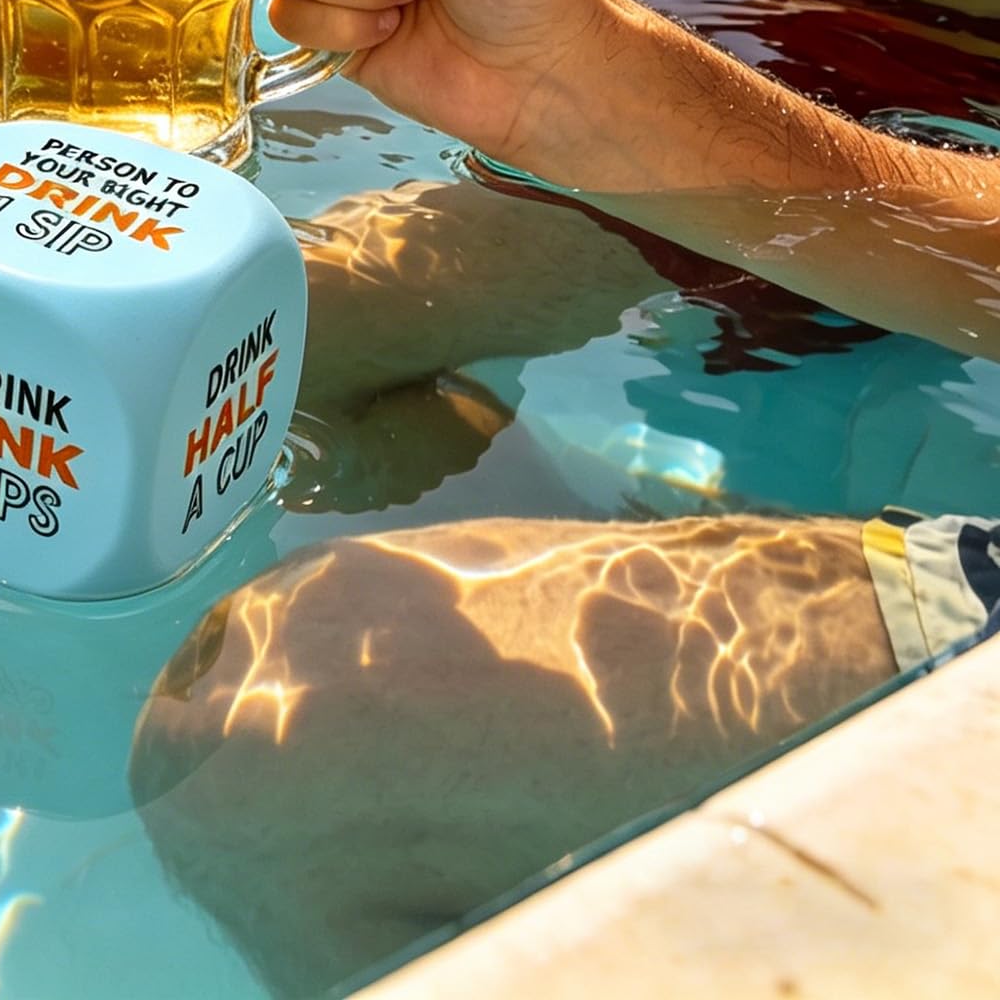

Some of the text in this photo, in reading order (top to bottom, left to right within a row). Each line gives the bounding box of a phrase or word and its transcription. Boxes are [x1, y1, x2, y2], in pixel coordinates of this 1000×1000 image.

[20, 151, 96, 188] YOUR
[41, 138, 200, 198] PERSON TO
[15, 209, 113, 256] SIP
[206, 308, 277, 409] DRINK
[183, 348, 279, 478] HALF
[181, 410, 269, 535] A CUP
